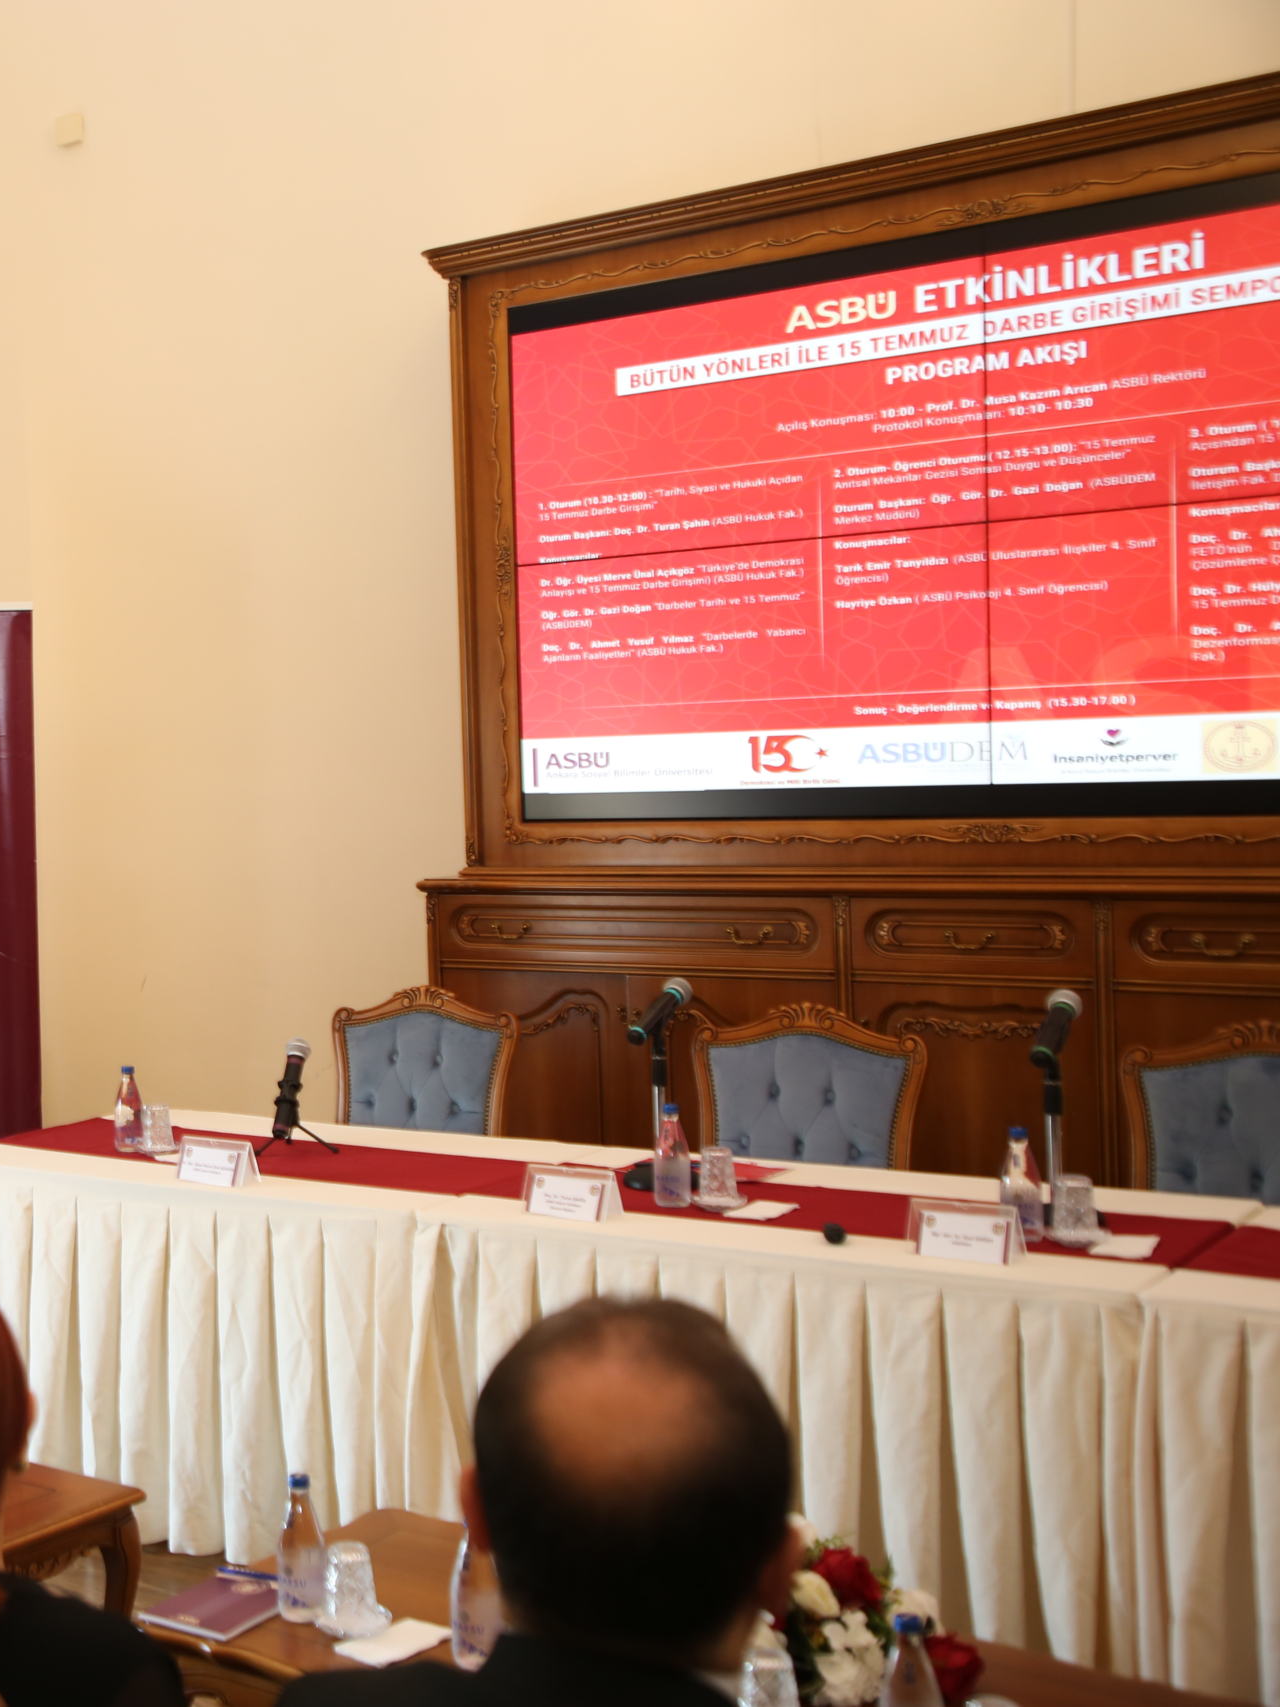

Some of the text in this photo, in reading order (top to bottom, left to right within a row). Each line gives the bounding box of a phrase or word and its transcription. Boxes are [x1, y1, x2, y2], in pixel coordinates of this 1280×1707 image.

[785, 230, 1204, 333] ASBÜ ETKİNLİKLERİ
[630, 366, 694, 387] BÜTÜN
[703, 348, 788, 376] YÖNLERİ
[798, 346, 826, 362] İLE
[838, 341, 860, 356] 15
[870, 324, 966, 351] TEMMUZ
[983, 310, 1060, 337] DARBE
[1072, 289, 1178, 322] GİRİŞİMİ
[885, 340, 1086, 384] PROGRAM AKIŞI
[545, 752, 610, 770] ASBÜ
